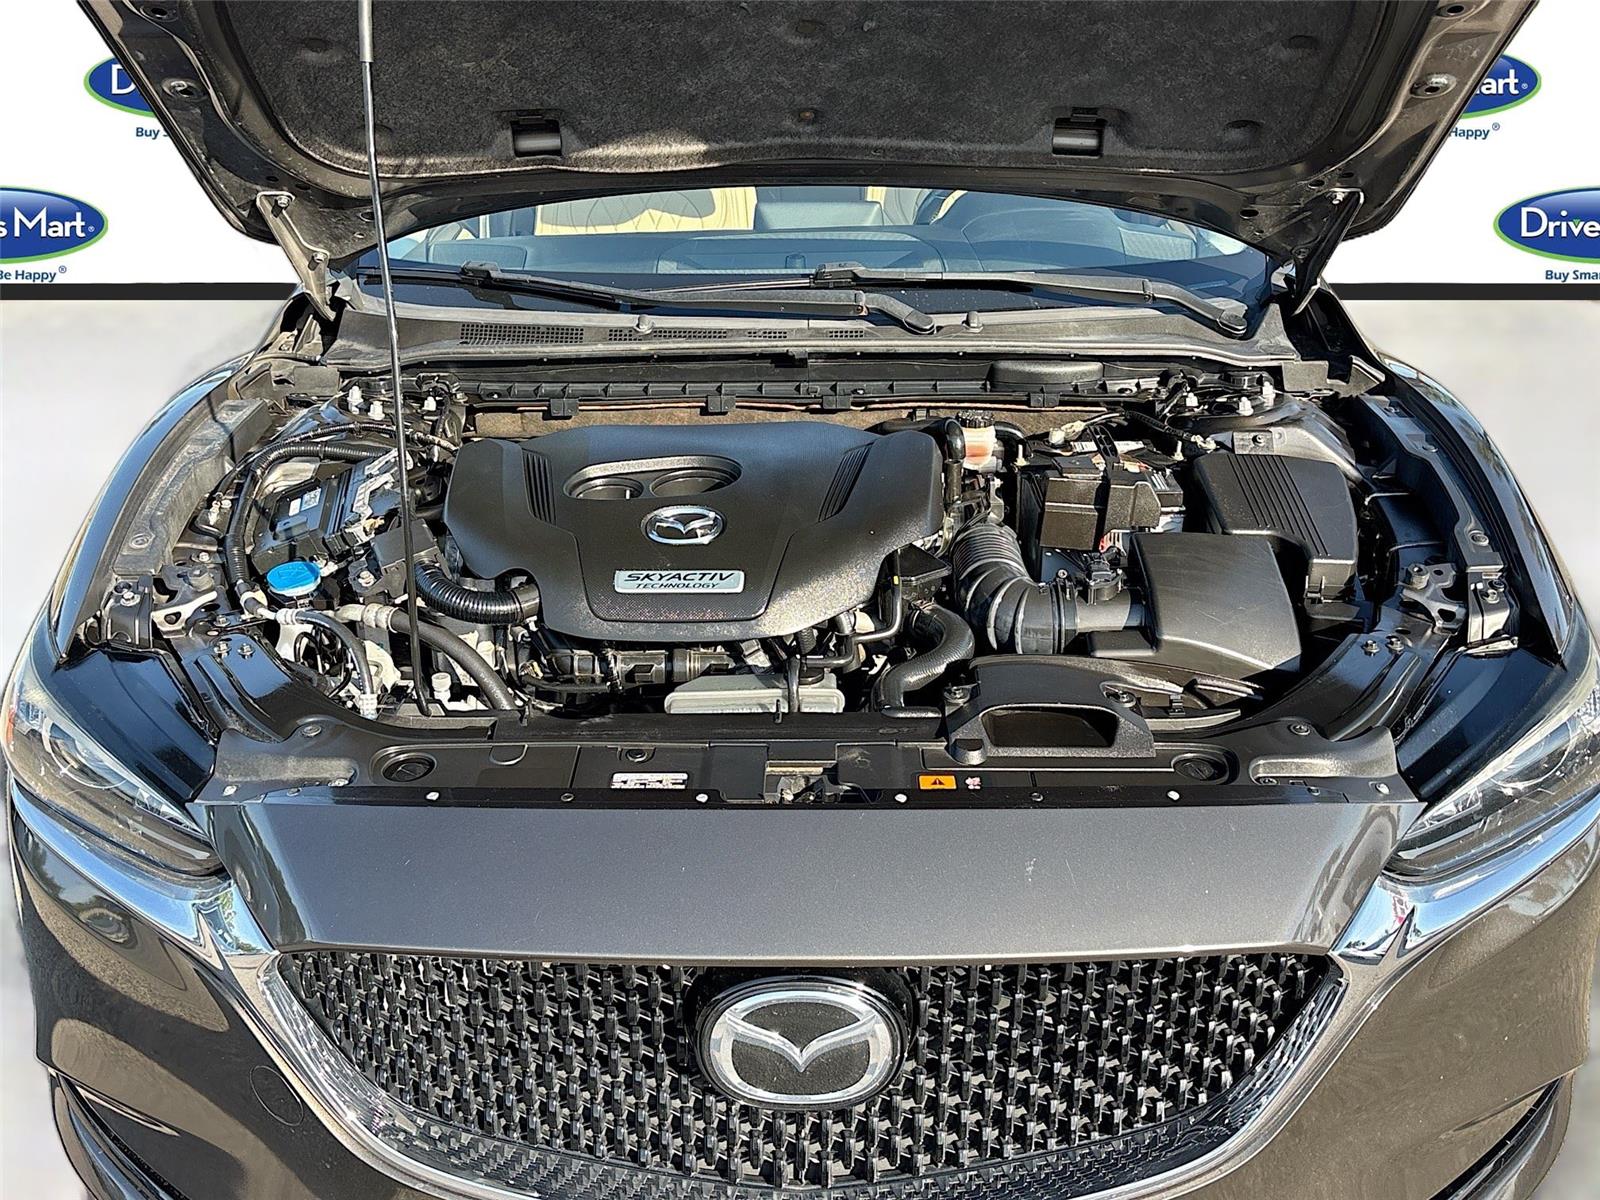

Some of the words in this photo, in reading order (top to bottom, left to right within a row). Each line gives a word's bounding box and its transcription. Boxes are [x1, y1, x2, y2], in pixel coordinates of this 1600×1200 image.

[1475, 68, 1519, 95] art
[135, 127, 160, 140] Buy
[1450, 128, 1490, 140] Happy
[14, 206, 86, 238] Mart
[1521, 206, 1600, 238] Drive
[15, 270, 57, 283] Happy
[1545, 270, 1570, 283] Buy
[623, 572, 736, 582] SKYACTIV
